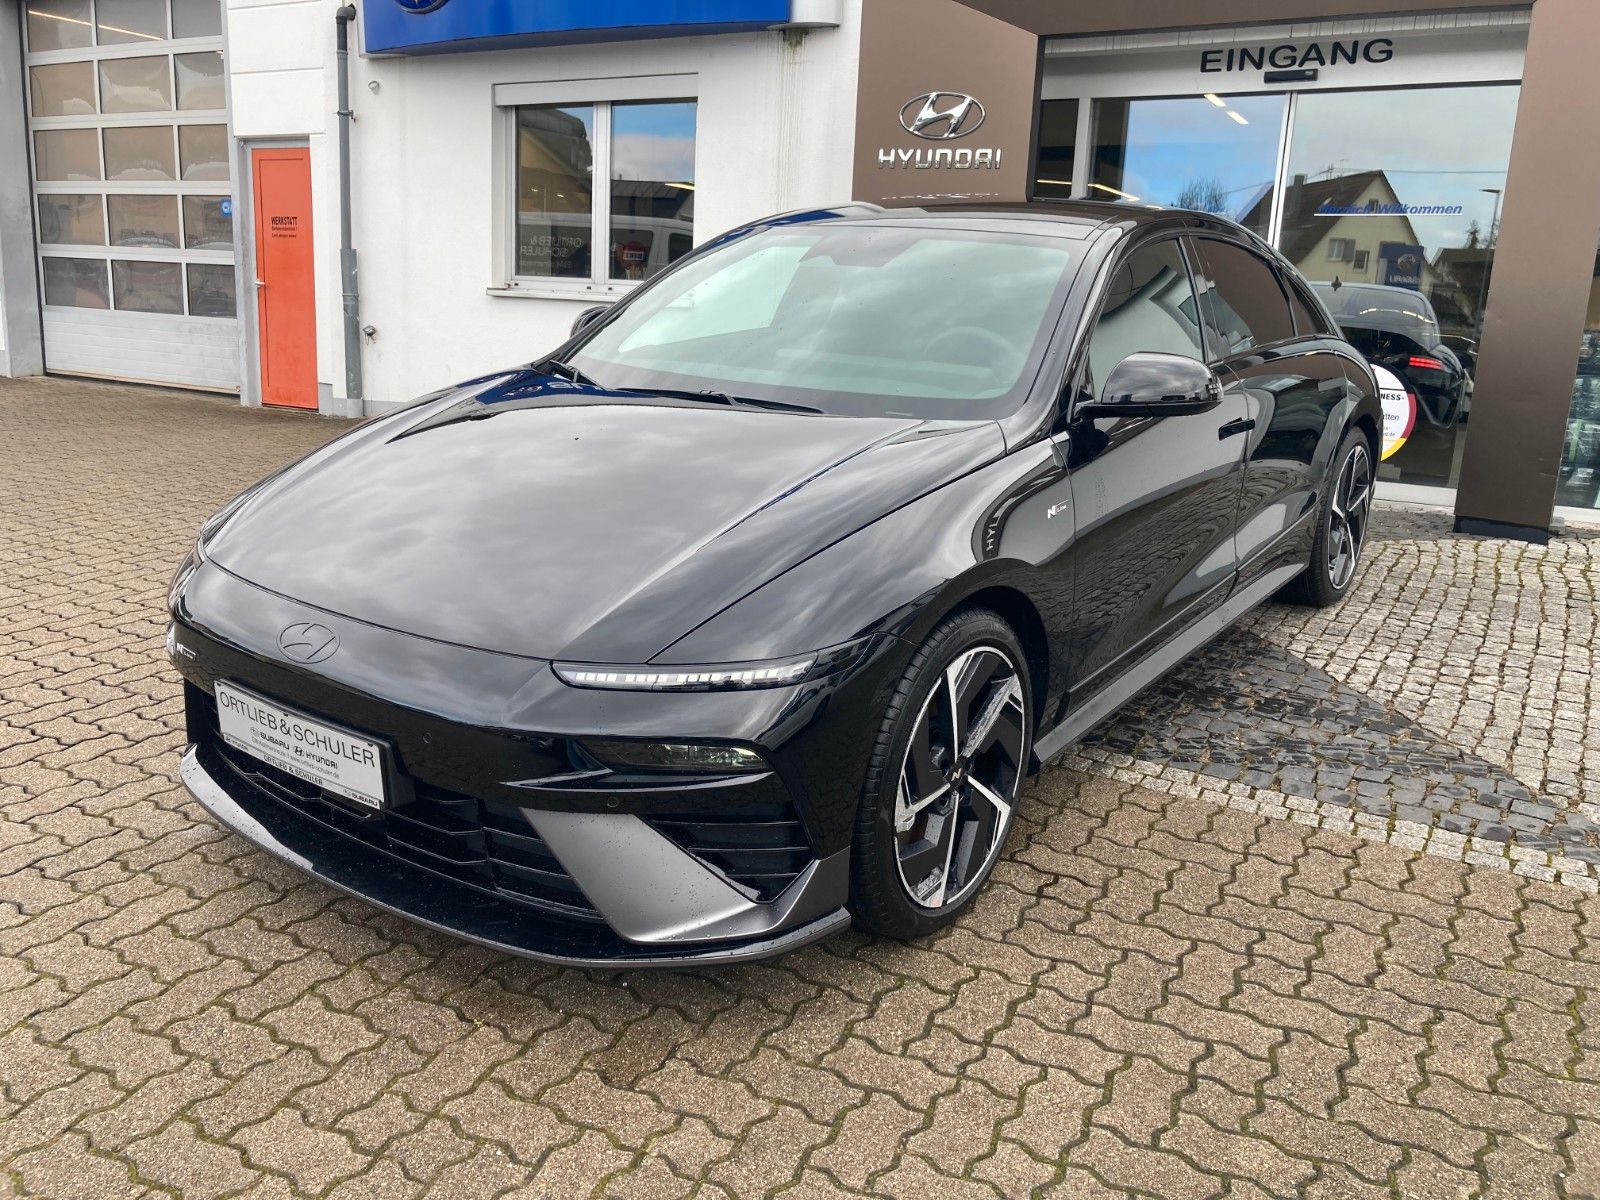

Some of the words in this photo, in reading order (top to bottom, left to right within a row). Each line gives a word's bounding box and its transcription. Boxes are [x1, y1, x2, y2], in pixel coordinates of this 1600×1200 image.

[1200, 38, 1393, 72] EINGANG
[878, 148, 1002, 169] HYUNDAI
[1318, 204, 1370, 214] Herzlich
[1377, 203, 1462, 214] Willkommen
[271, 216, 297, 225] WERKSTATT
[1383, 413, 1399, 421] tten
[260, 731, 290, 750] SUBARU
[306, 752, 338, 769] HYUNDAI
[264, 755, 287, 771] ORTLIEB
[295, 768, 323, 785] SCHULER
[351, 792, 378, 806] SUBARU
